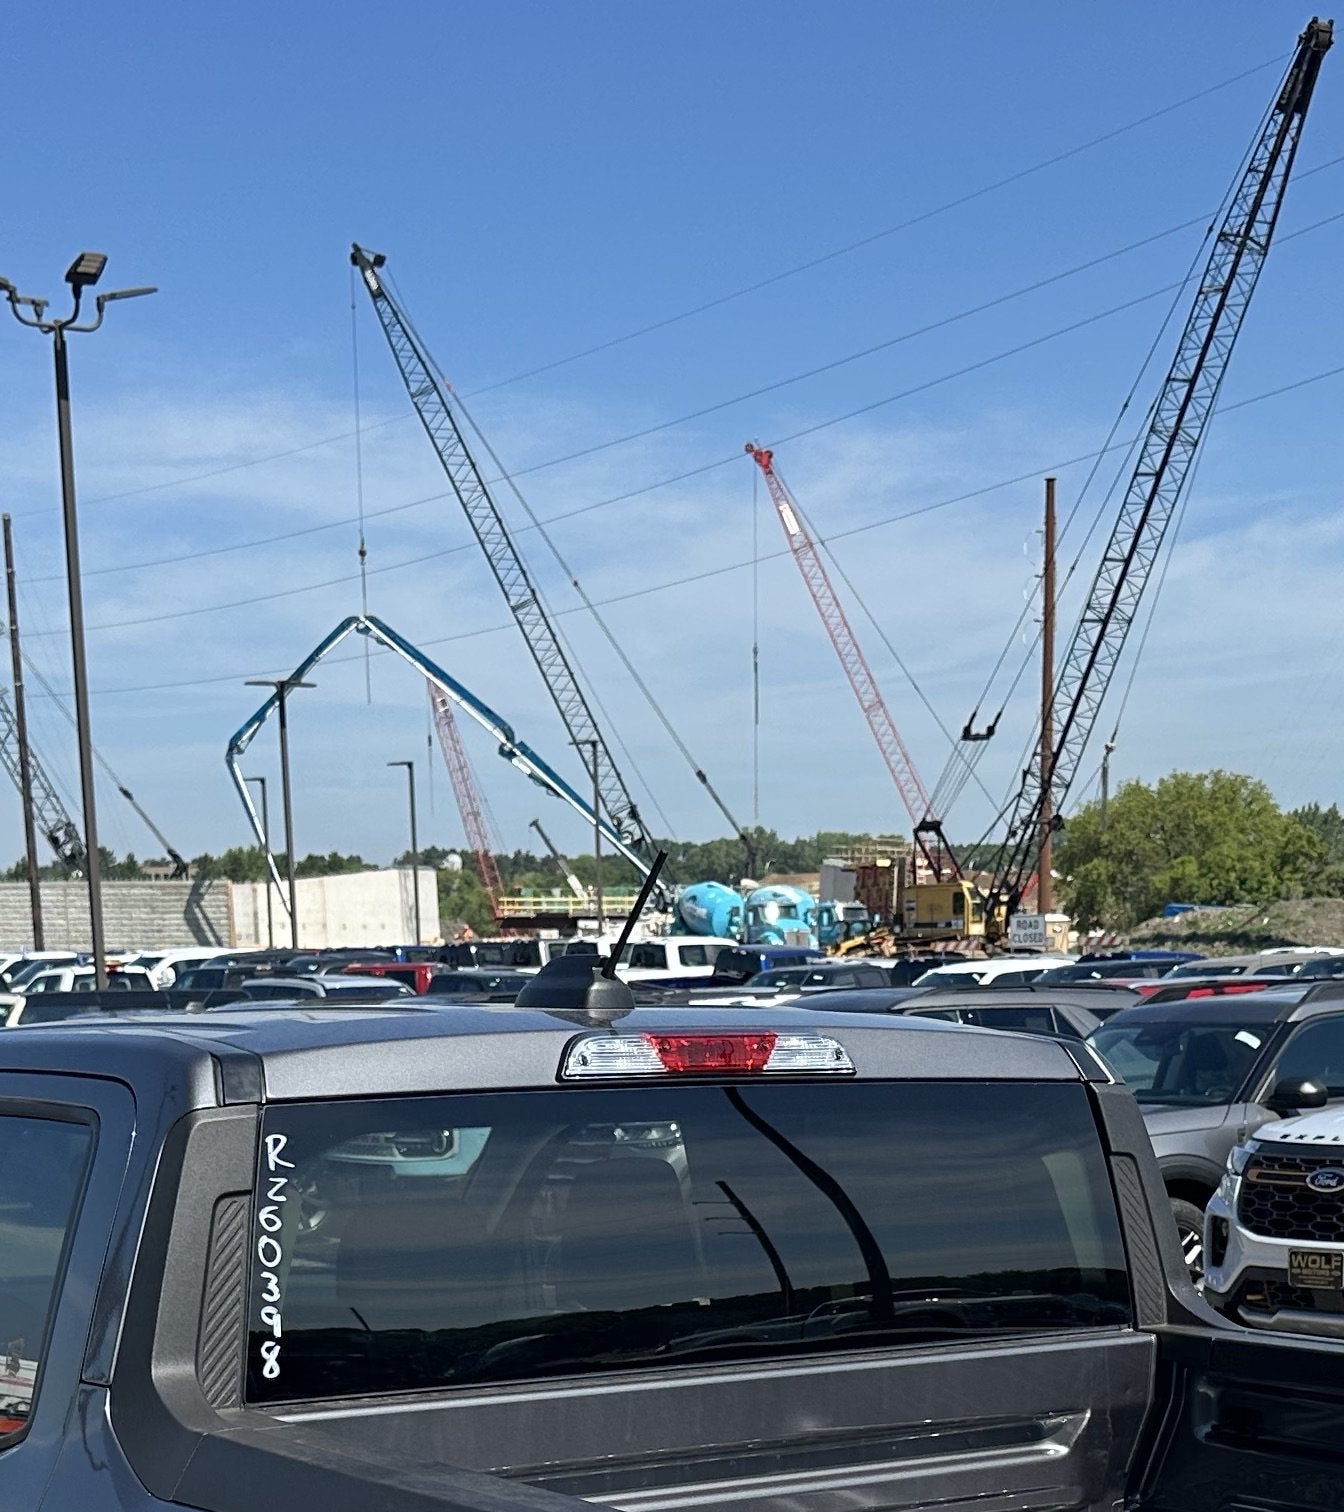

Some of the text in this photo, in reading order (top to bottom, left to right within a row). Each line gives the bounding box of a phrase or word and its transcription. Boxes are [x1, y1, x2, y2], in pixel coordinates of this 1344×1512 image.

[1016, 919, 1040, 931] ROAD
[1012, 931, 1045, 944] CLOSED
[1314, 1172, 1339, 1188] Ford
[1291, 1253, 1342, 1270] WOLF
